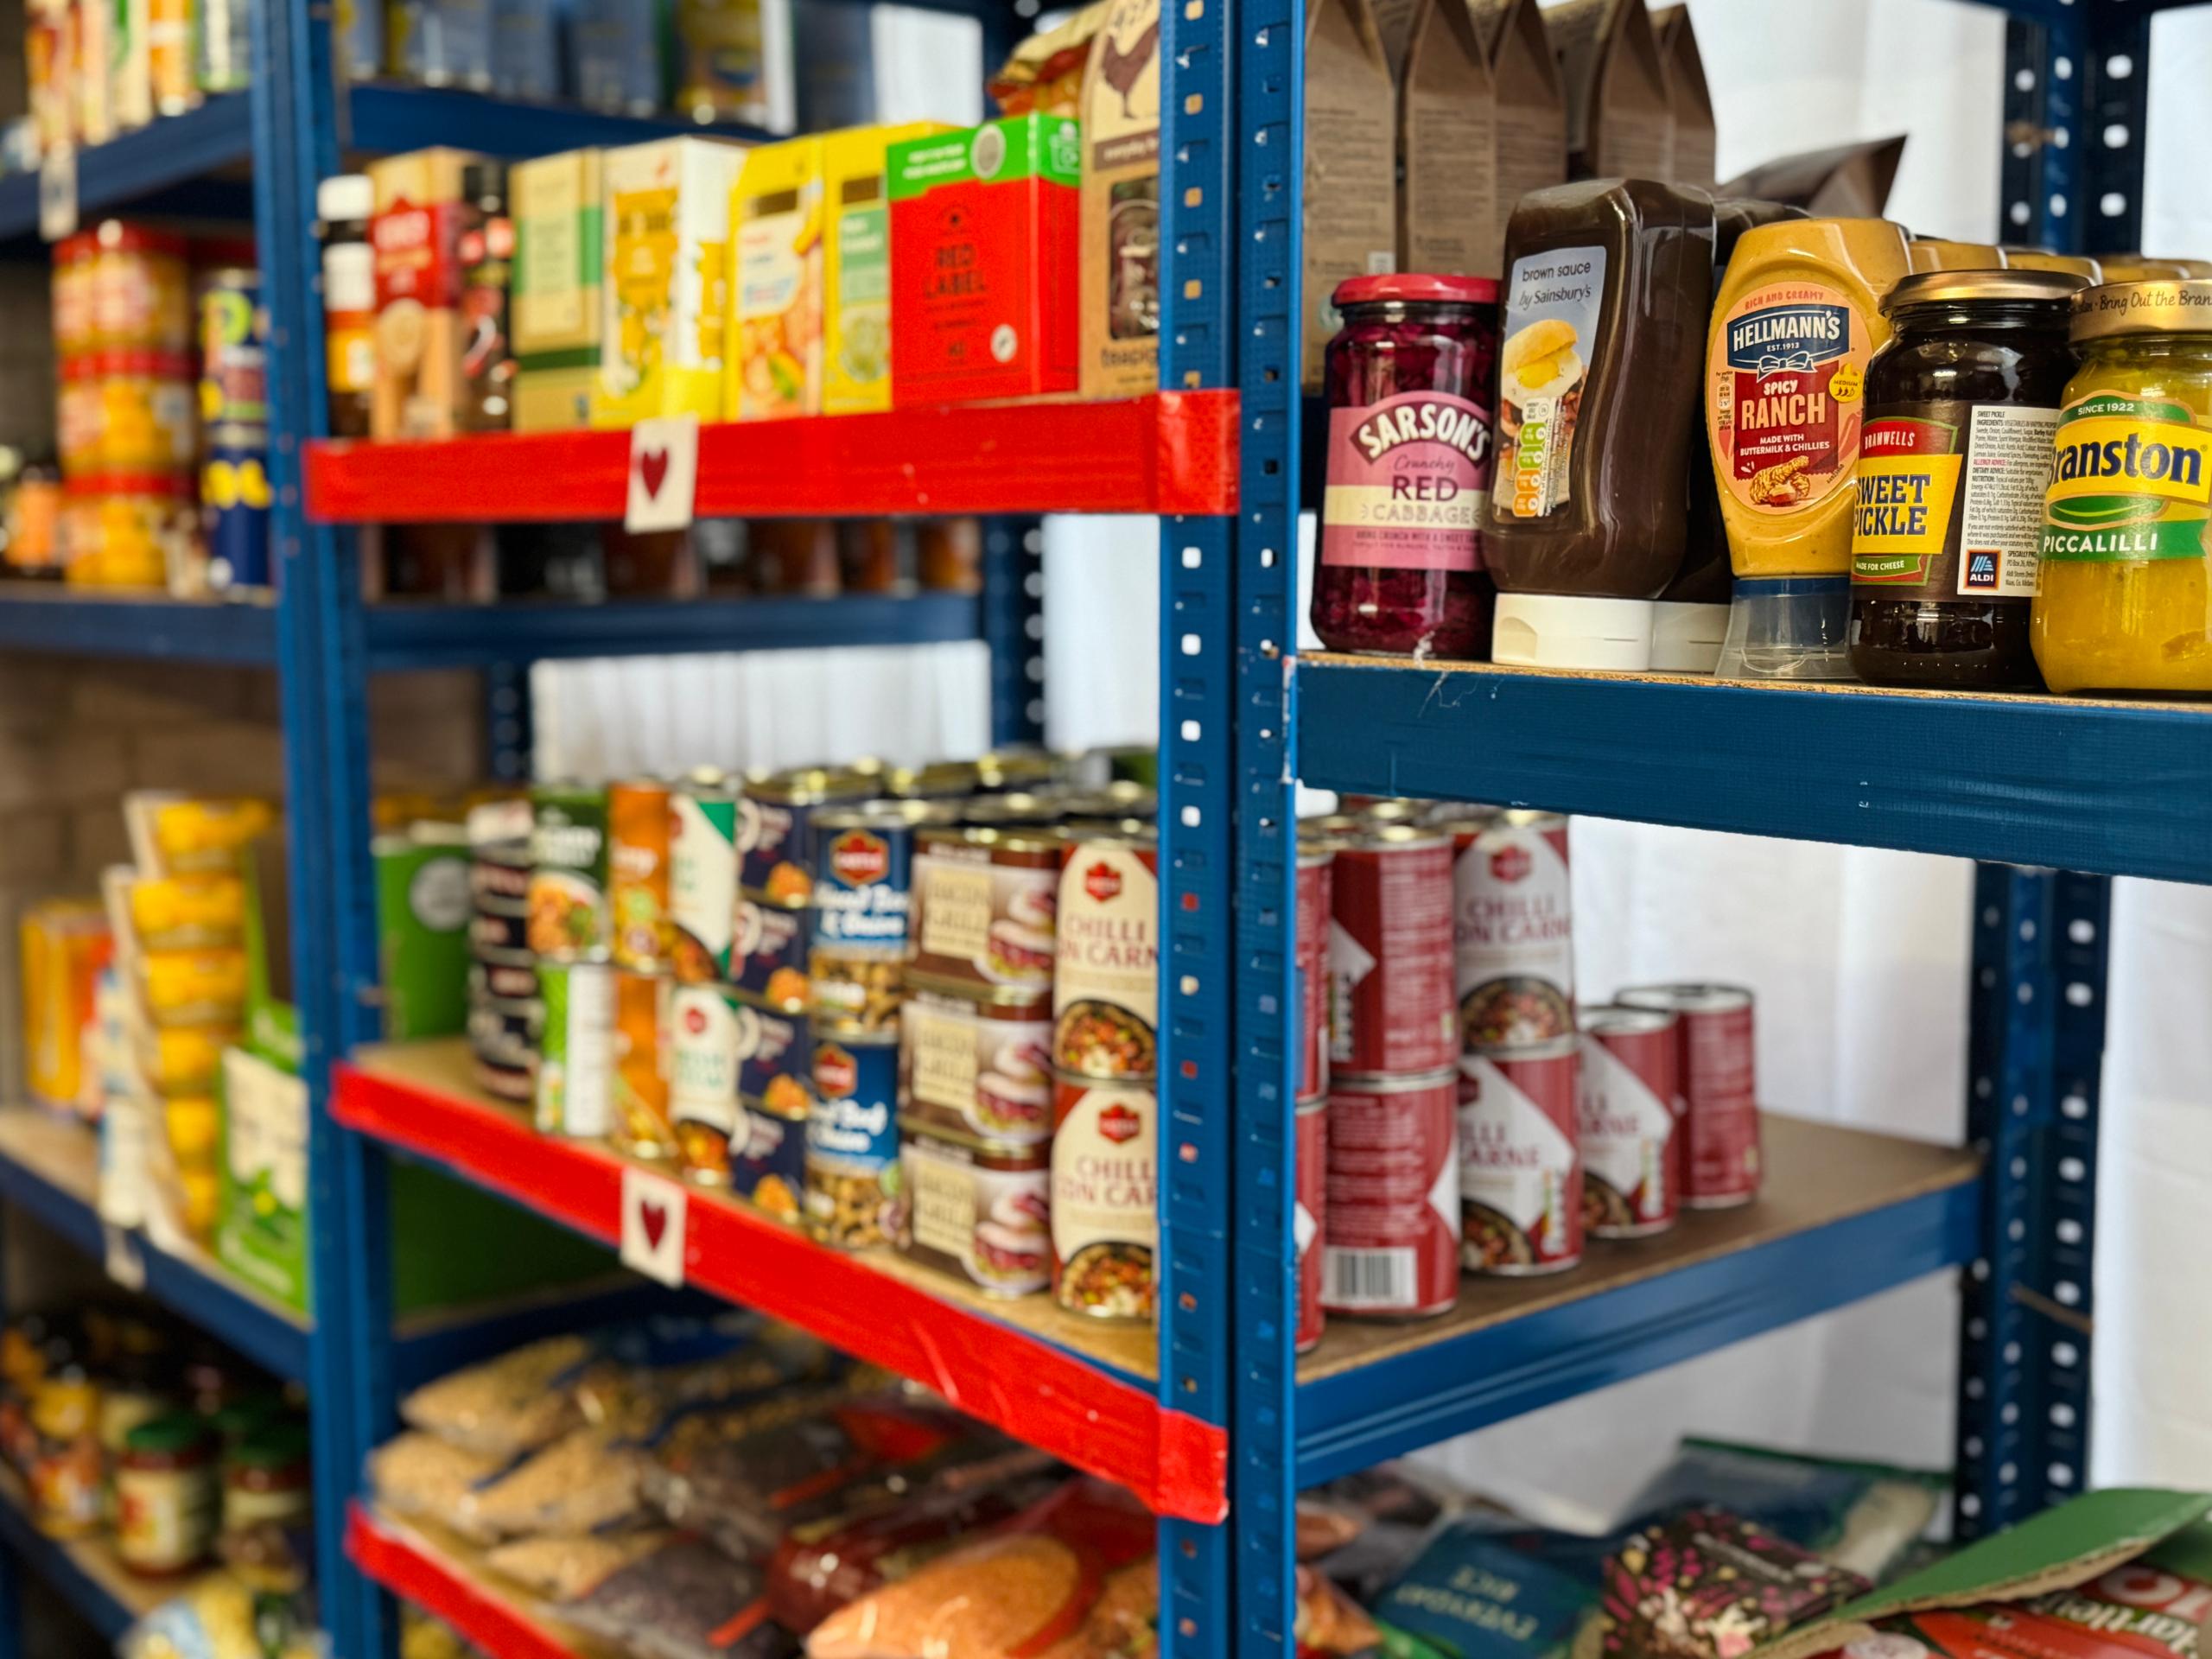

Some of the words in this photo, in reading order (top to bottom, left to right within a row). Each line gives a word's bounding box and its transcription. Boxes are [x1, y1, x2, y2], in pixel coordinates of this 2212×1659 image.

[1522, 268, 1554, 282] brown
[1558, 262, 1591, 276] sauce
[1518, 290, 1535, 311] by
[1534, 284, 1592, 304] Sainsbury's
[1745, 296, 1764, 310] RICH
[1766, 292, 1783, 302] AND
[1786, 290, 1824, 302] CREAMY
[2100, 295, 2127, 316] Bring
[2131, 291, 2153, 308] Out
[2156, 290, 2176, 307] the
[1733, 310, 1840, 352] HELLMANN'S
[1764, 379, 1798, 396] SPICY
[1741, 392, 1826, 430] RANCH
[2078, 404, 2104, 415] SINCE
[2107, 404, 2134, 412] 1922
[1358, 403, 1491, 461] SARSON'S
[1760, 435, 1782, 444] MADE
[1783, 434, 1804, 442] WITH
[1740, 444, 1783, 456] BUTTERMILK
[1792, 442, 1830, 451] CHILLIES
[1394, 454, 1455, 474] Crunchy
[1391, 475, 1459, 501] RED
[1372, 504, 1471, 524] CABBAGE
[2044, 533, 2158, 553] PICCALILLI
[1880, 560, 1904, 570] CHEESE
